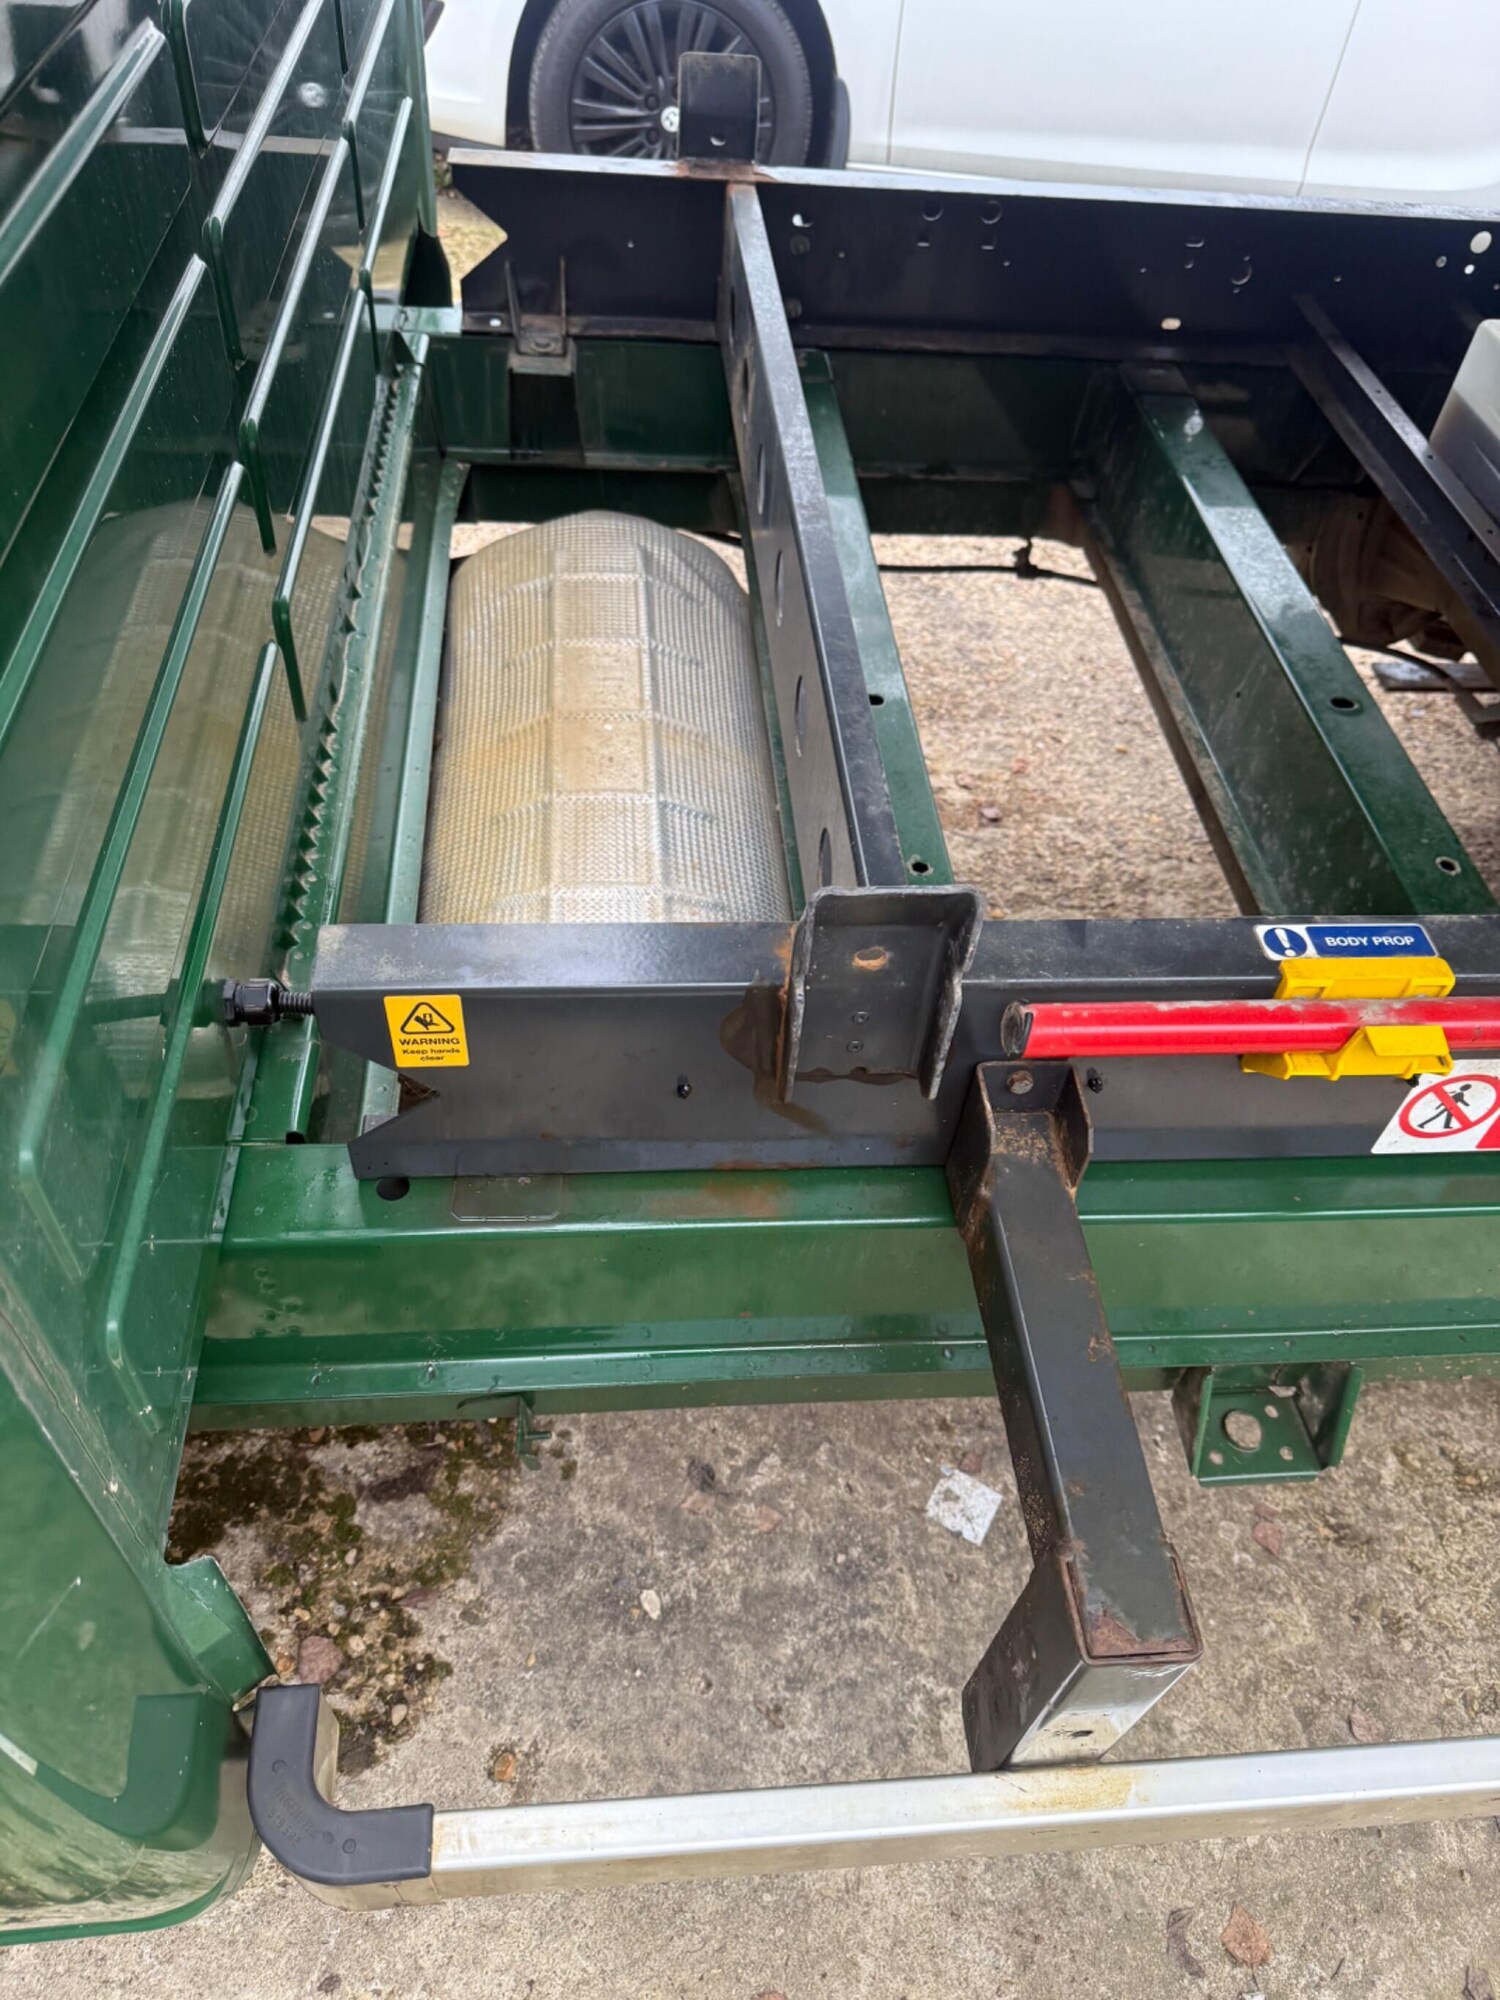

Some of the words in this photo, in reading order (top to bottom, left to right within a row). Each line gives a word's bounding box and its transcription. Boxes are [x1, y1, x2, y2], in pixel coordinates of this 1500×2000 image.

[1324, 936, 1368, 947] BODY
[1372, 935, 1415, 946] PROP
[399, 1037, 460, 1046] WARNING
